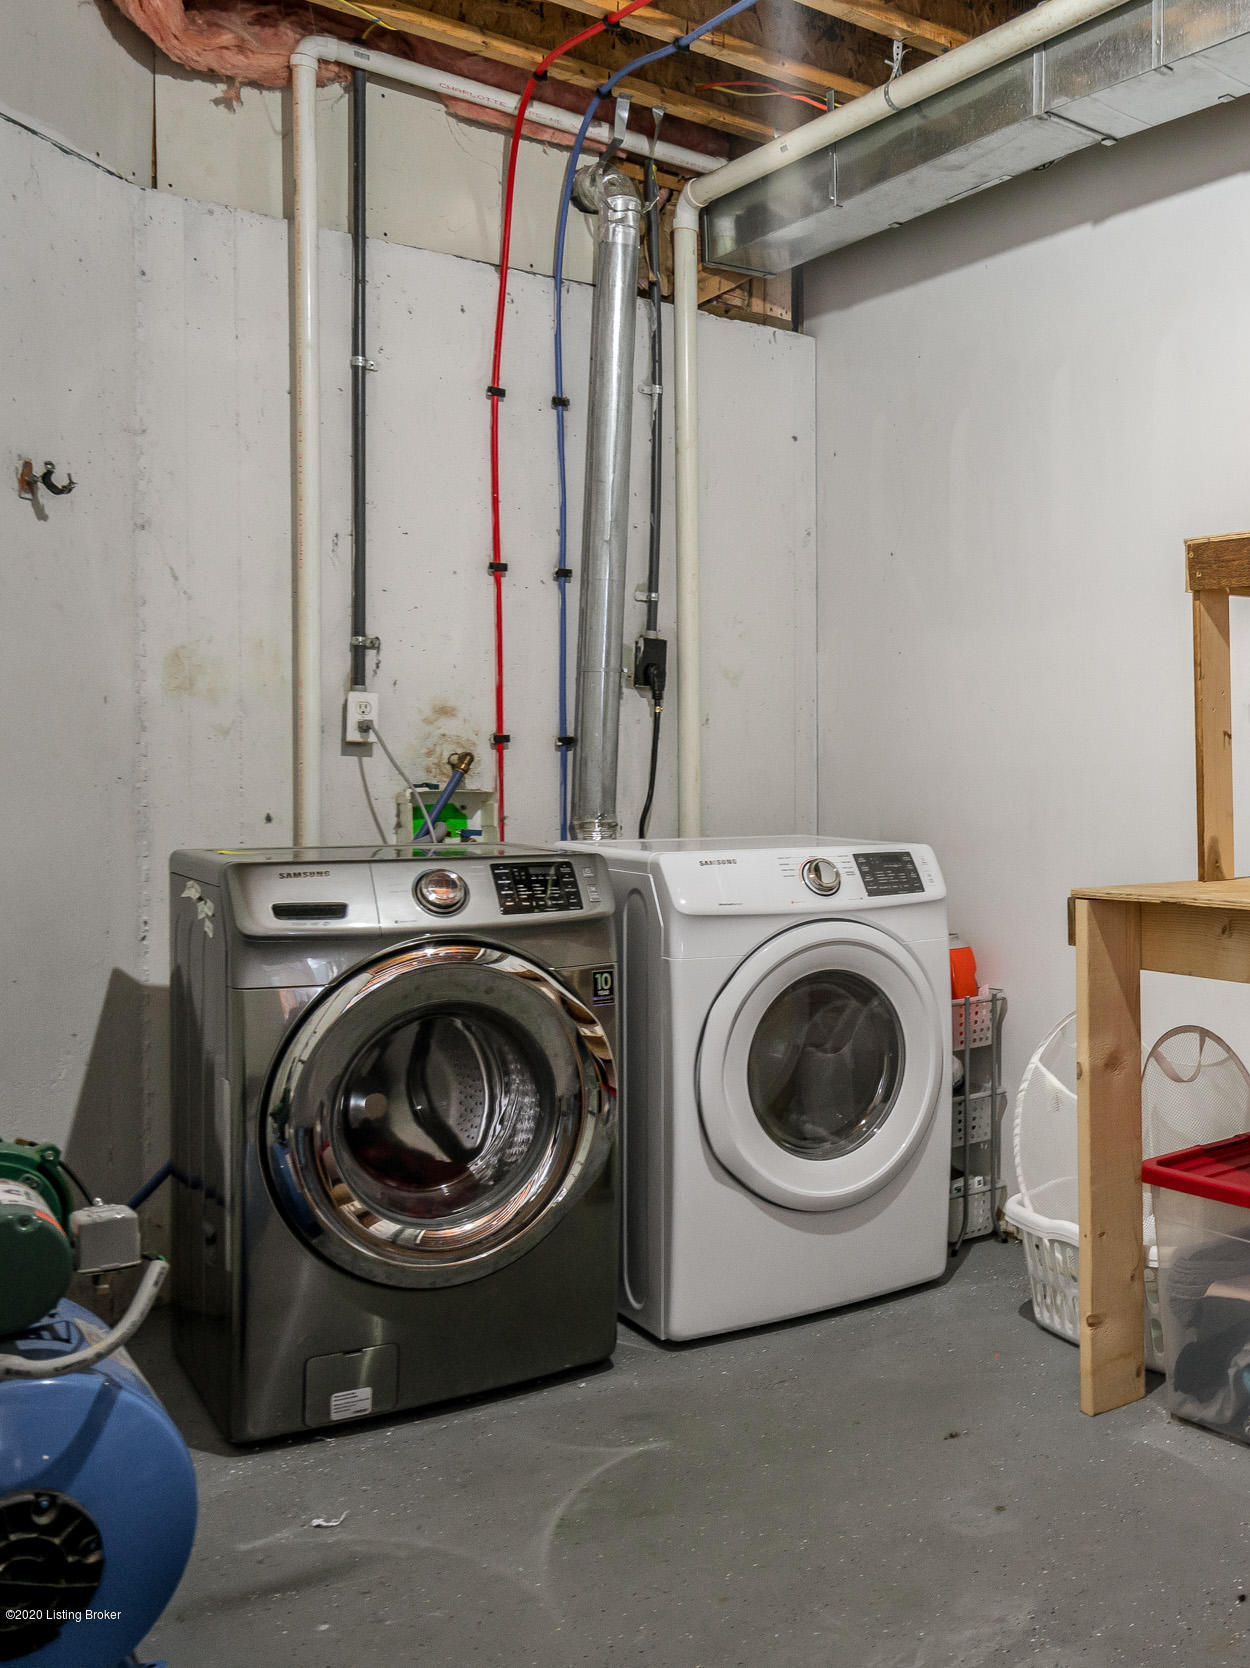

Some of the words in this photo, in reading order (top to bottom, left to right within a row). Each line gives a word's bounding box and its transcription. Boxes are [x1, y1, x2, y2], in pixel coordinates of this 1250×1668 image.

[698, 858, 738, 867] SAMSUNG
[278, 870, 331, 880] SAMSUNG
[594, 972, 612, 990] 10
